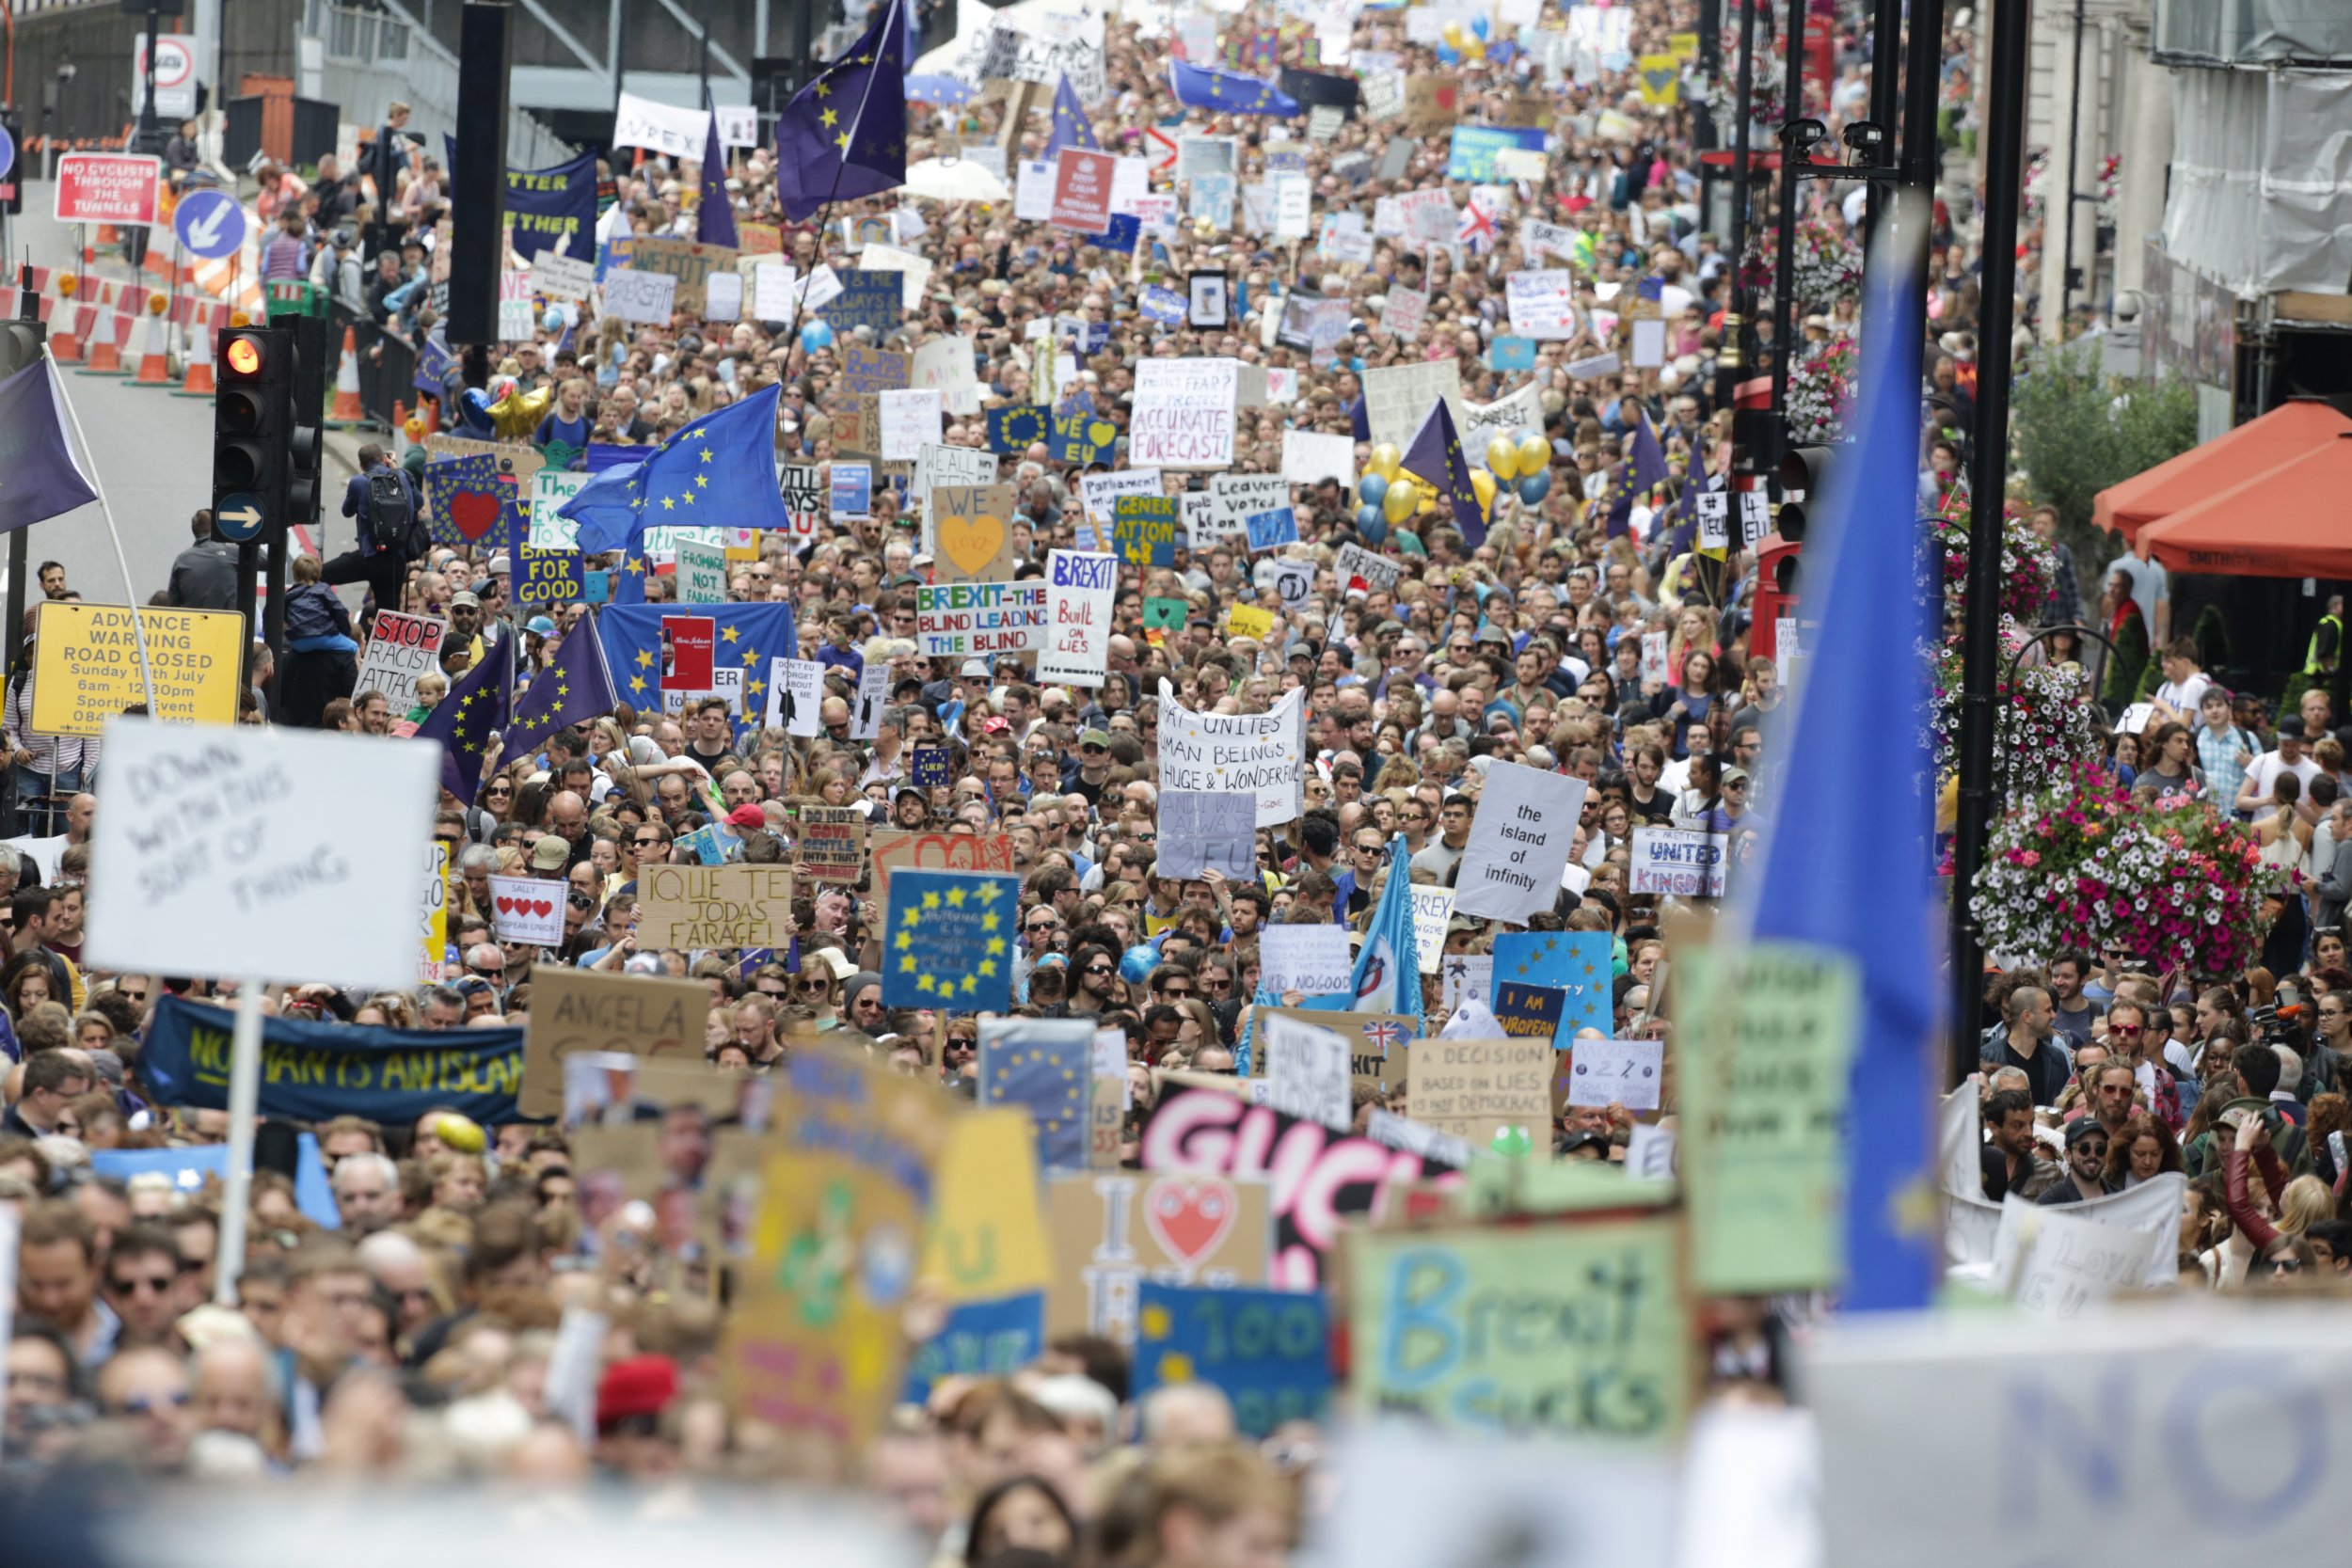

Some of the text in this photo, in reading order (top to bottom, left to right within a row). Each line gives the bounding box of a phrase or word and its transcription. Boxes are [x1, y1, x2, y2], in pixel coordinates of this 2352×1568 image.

[63, 162, 154, 178] NO CYCLISTS
[73, 175, 144, 190] THROUGH
[94, 188, 120, 201] THE
[73, 200, 139, 214] TUNNELS
[1054, 416, 1082, 438] WE
[1132, 408, 1228, 433] ACCURATE
[1065, 443, 1095, 464] EU
[1135, 432, 1229, 462] FORECAST!
[926, 448, 943, 472] WE
[948, 451, 975, 476] ALL
[540, 474, 577, 497] The
[947, 489, 988, 515] WE
[1117, 497, 1173, 515] GENER
[1114, 519, 1174, 544] ATION
[1744, 520, 1767, 542] EU
[682, 550, 724, 571] FROMAGE
[1124, 541, 1153, 566] 48
[2188, 550, 2230, 564] SMITH
[529, 562, 570, 581] FOR
[692, 572, 717, 591] NOT
[1054, 555, 1118, 591] BREXIT
[519, 580, 578, 604] GOOD
[91, 612, 191, 631] ADVANCE
[918, 610, 1048, 632] BLIND LEADING
[1057, 598, 1093, 626] Built
[88, 630, 191, 649] WARNING
[374, 613, 440, 647] STOP
[1069, 628, 1084, 639] ON
[928, 631, 1027, 654] THE BLIND
[1057, 640, 1089, 653] LIES
[64, 647, 120, 663] ROAD
[369, 641, 437, 671] RACIST
[70, 663, 205, 684] Sunday 1th July
[778, 660, 815, 672] DON'T EU
[782, 672, 814, 680] FORGET
[77, 679, 109, 692] 6am
[1204, 715, 1282, 736] UNITES
[1214, 741, 1285, 766] BEINGS
[125, 747, 243, 807] DOWN
[925, 763, 936, 771] UK
[1165, 762, 1300, 790] HUGE & WONDERFUL
[805, 809, 856, 822] DO NOT
[1161, 796, 1195, 816] AND
[1216, 796, 1253, 815] WILL
[1517, 804, 1542, 822] the
[809, 824, 850, 838] GOVE
[1172, 815, 1253, 834] ALWAYS
[1500, 822, 1547, 847] island
[803, 838, 855, 852] GENTLE
[1649, 842, 1721, 865] UNITED
[803, 851, 860, 863] INTO THAT
[1202, 843, 1251, 875] EU
[1510, 849, 1528, 864] of
[511, 883, 536, 894] SALLY
[739, 869, 789, 899] TE
[1485, 863, 1537, 893] infinity
[1637, 867, 1724, 896] KINGDOM
[687, 900, 768, 923] JODAS
[530, 923, 556, 933] UNION
[670, 922, 772, 948] FARAGE!
[1422, 924, 1443, 936] GIVE
[1422, 939, 1431, 948] TO
[1507, 991, 1544, 1010] I AM
[553, 993, 685, 1038] ANGELA
[189, 1025, 433, 1092] NO MAN IS AN
[1422, 1046, 1544, 1065] A DECISION
[1422, 1071, 1542, 1091] BASED ON LIES
[1412, 1095, 1550, 1112] IS NOT DEMOCRACY
[1091, 1178, 1138, 1263] I
[1193, 1294, 1323, 1364] 100
[1384, 1247, 1648, 1391] Brexit
[1996, 1350, 2331, 1543] NO
